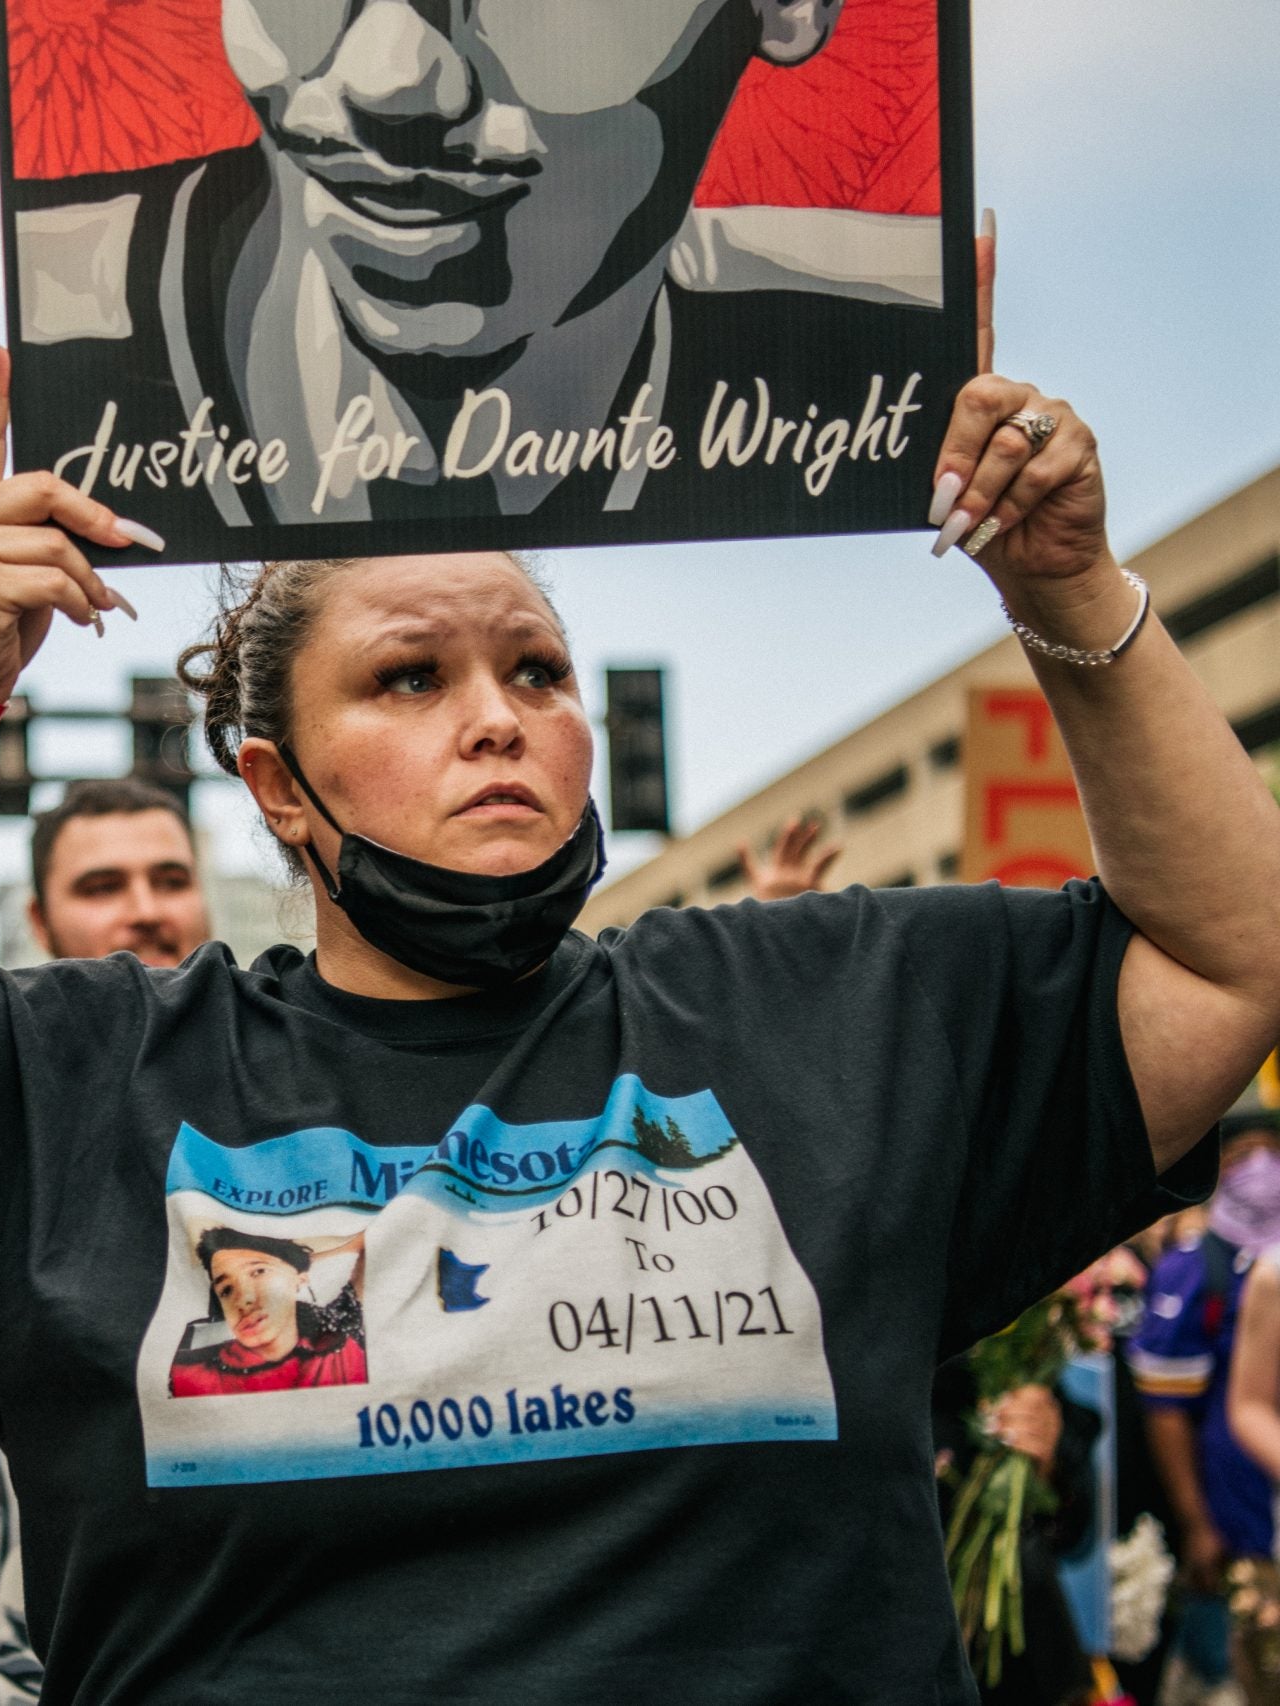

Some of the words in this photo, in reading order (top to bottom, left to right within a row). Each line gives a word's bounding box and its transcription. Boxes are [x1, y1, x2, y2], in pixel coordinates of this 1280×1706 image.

[53, 397, 290, 497] Justice
[311, 394, 421, 515] for
[443, 382, 678, 480] Daunte
[700, 372, 923, 497] Wright
[213, 1177, 328, 1207] EXPLORE
[529, 1170, 739, 1237] 10/27/00
[625, 1236, 676, 1273] To
[548, 1286, 795, 1355] 04/11/21
[357, 1395, 494, 1450] 10,000
[506, 1384, 637, 1436] lakes
